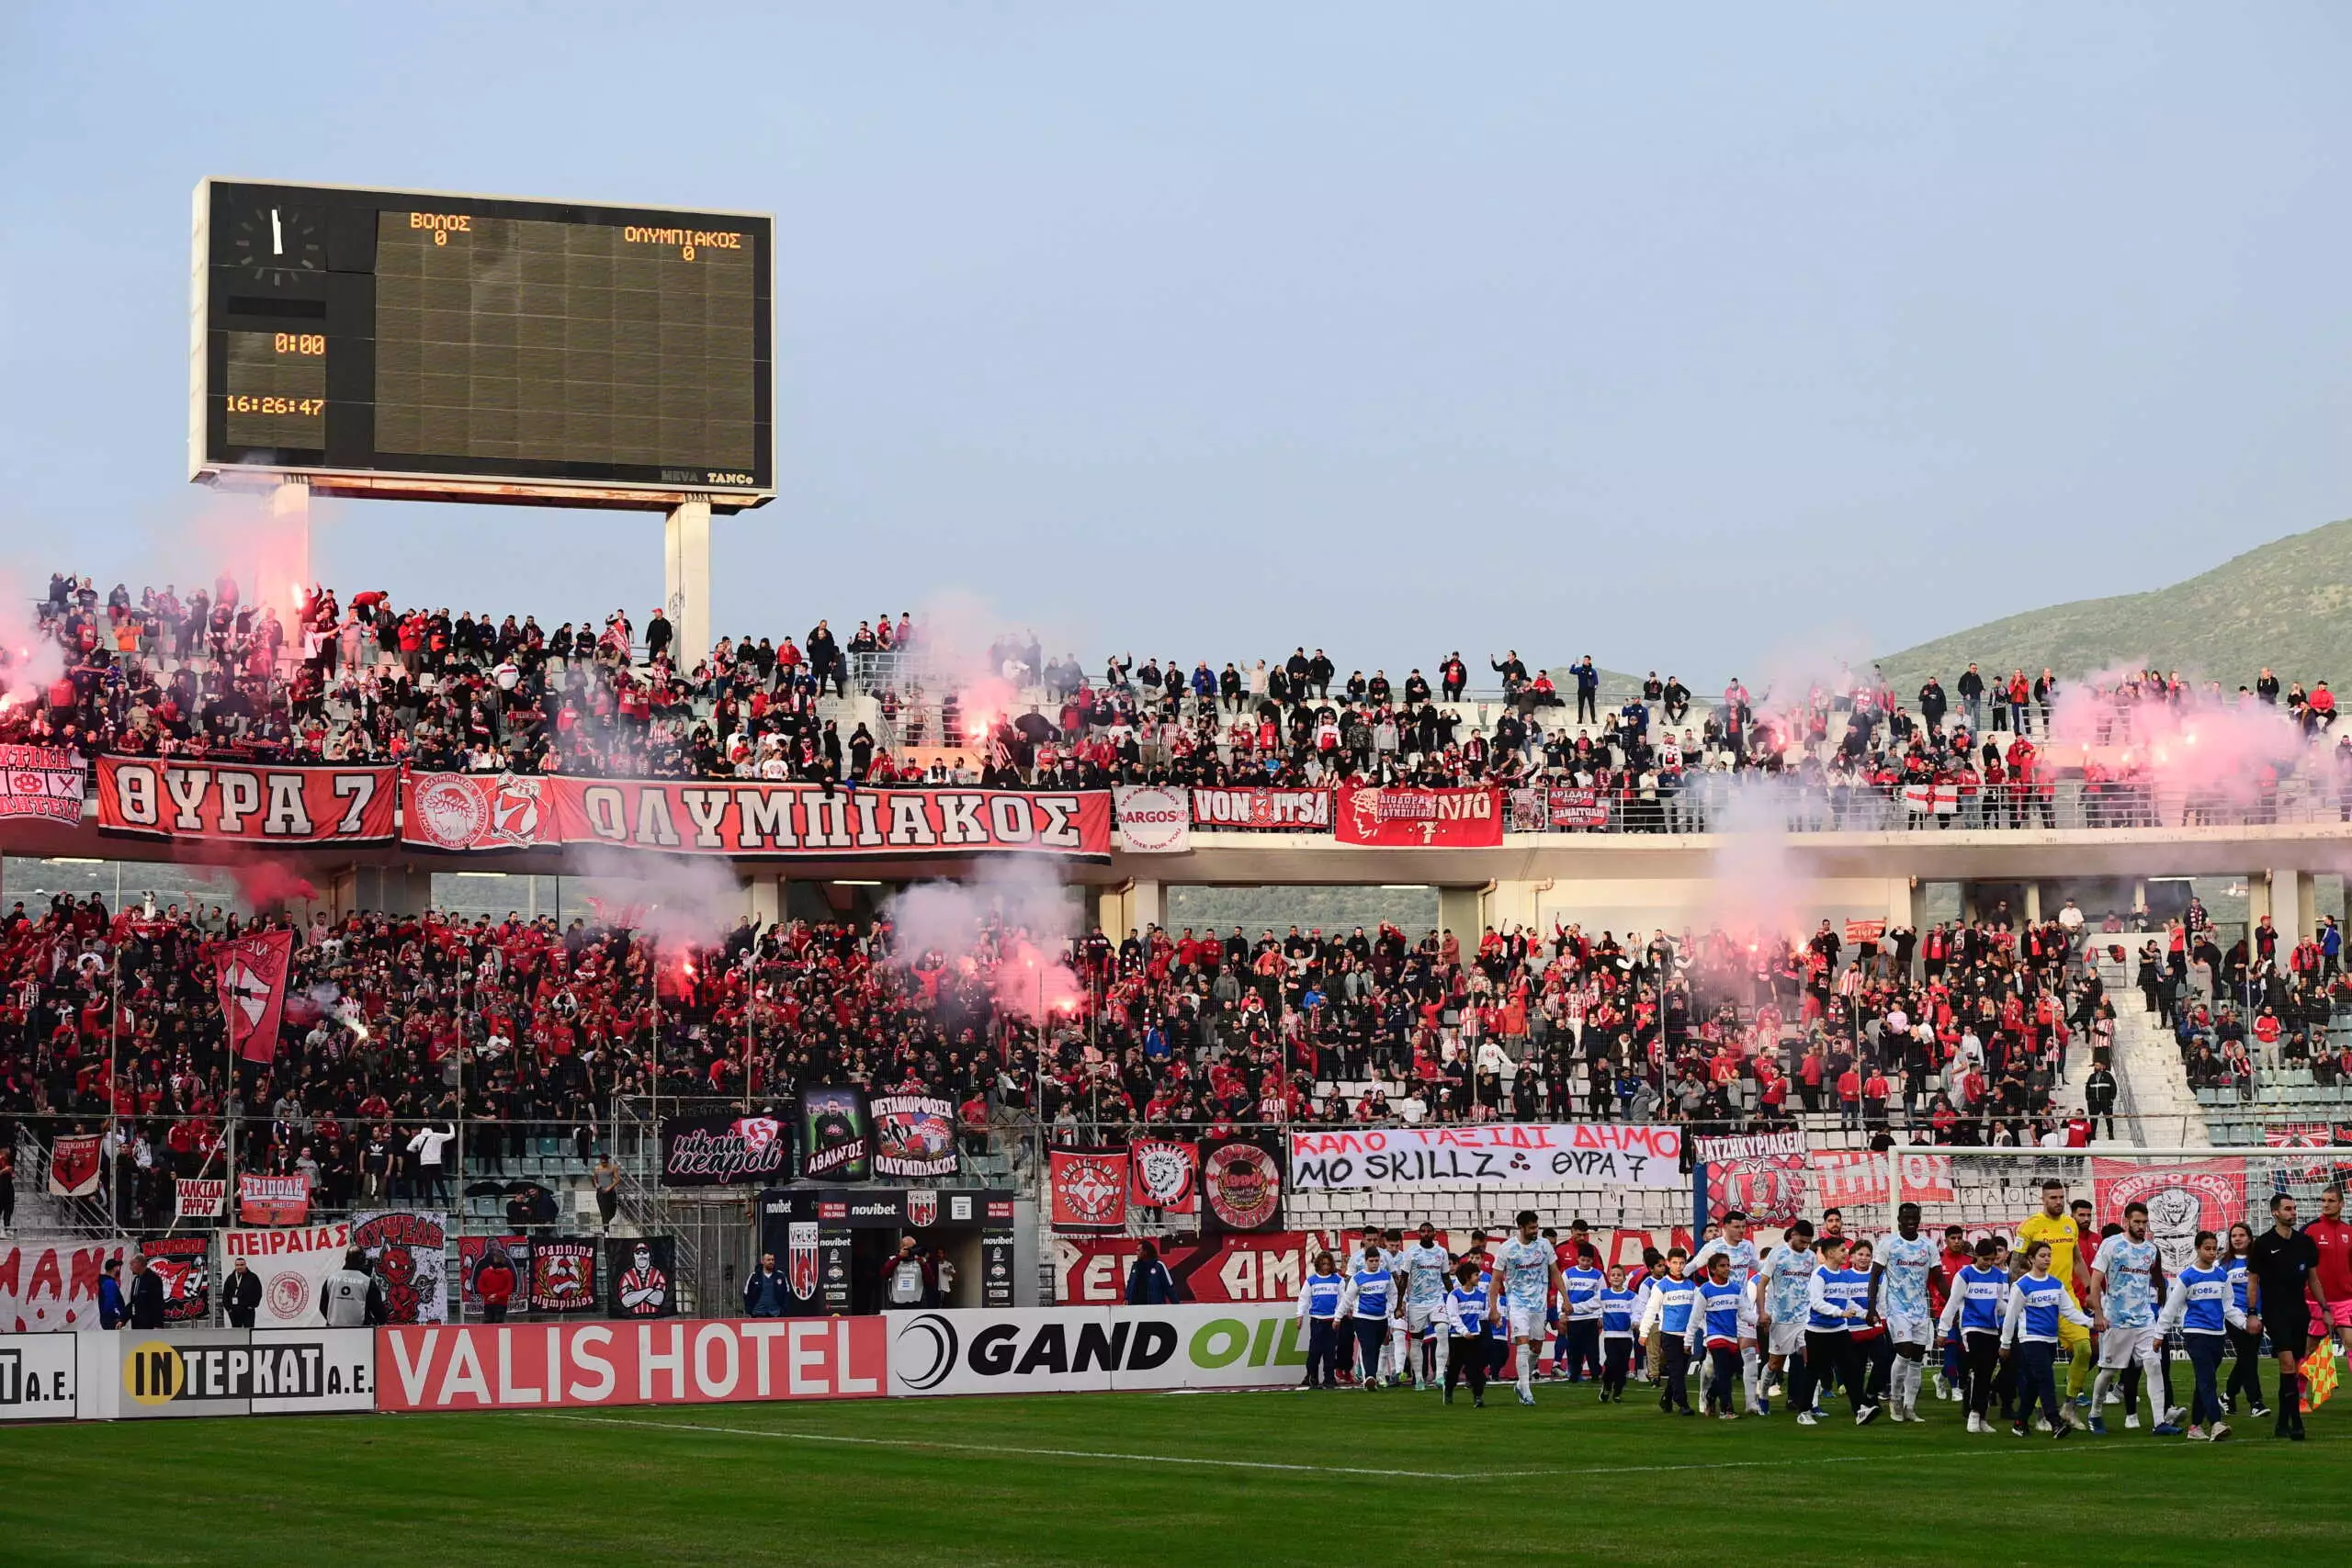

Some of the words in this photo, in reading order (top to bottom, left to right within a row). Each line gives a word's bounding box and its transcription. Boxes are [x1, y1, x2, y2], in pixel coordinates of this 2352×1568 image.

[410, 212, 471, 231] ΒΟΛΟΣ
[435, 230, 447, 246] 0
[624, 226, 741, 249] ΟΛΥΜΠΙΑΚΟΣ
[683, 246, 695, 261] 0
[275, 333, 325, 355] 0:00
[227, 395, 324, 416] 16:26:47
[115, 764, 312, 834] ΘΥΡΑ
[335, 772, 376, 833] 7
[583, 784, 1081, 849] ΟΛΥΜΠΙΑΚΟΣ
[1125, 810, 1177, 823] ARGOS
[870, 1096, 954, 1119] ΜΕΤΑΜΟΡΦΩΣΗ
[1417, 1124, 1557, 1150] ΤΑΞΙΔΙ
[1574, 1126, 1679, 1158] ΔΗΜΟ
[876, 1155, 958, 1176] ΟΛΥΜΠΙΑΚΟΣ
[1365, 1150, 1507, 1183] SKILLZ
[1552, 1151, 1617, 1178] ΘΥΡΑ
[1624, 1152, 1648, 1182] 7
[2111, 1172, 2184, 1206] GRUPPO
[2188, 1174, 2234, 1204] LOCO
[766, 1199, 792, 1213] novibet
[851, 1203, 897, 1215] novibet
[227, 1224, 351, 1256] ΠΕΙΡΑΙΑΣ
[533, 1242, 594, 1258] ioannina
[820, 1238, 852, 1247] novibet
[983, 1236, 1013, 1245] novibet
[531, 1294, 594, 1311] olympiakos
[967, 1321, 1178, 1376] GAND
[1188, 1318, 1310, 1370] OIL
[388, 1325, 617, 1406] VALIS
[638, 1320, 878, 1401] HOTEL
[327, 1364, 374, 1394] Α.Ε.
